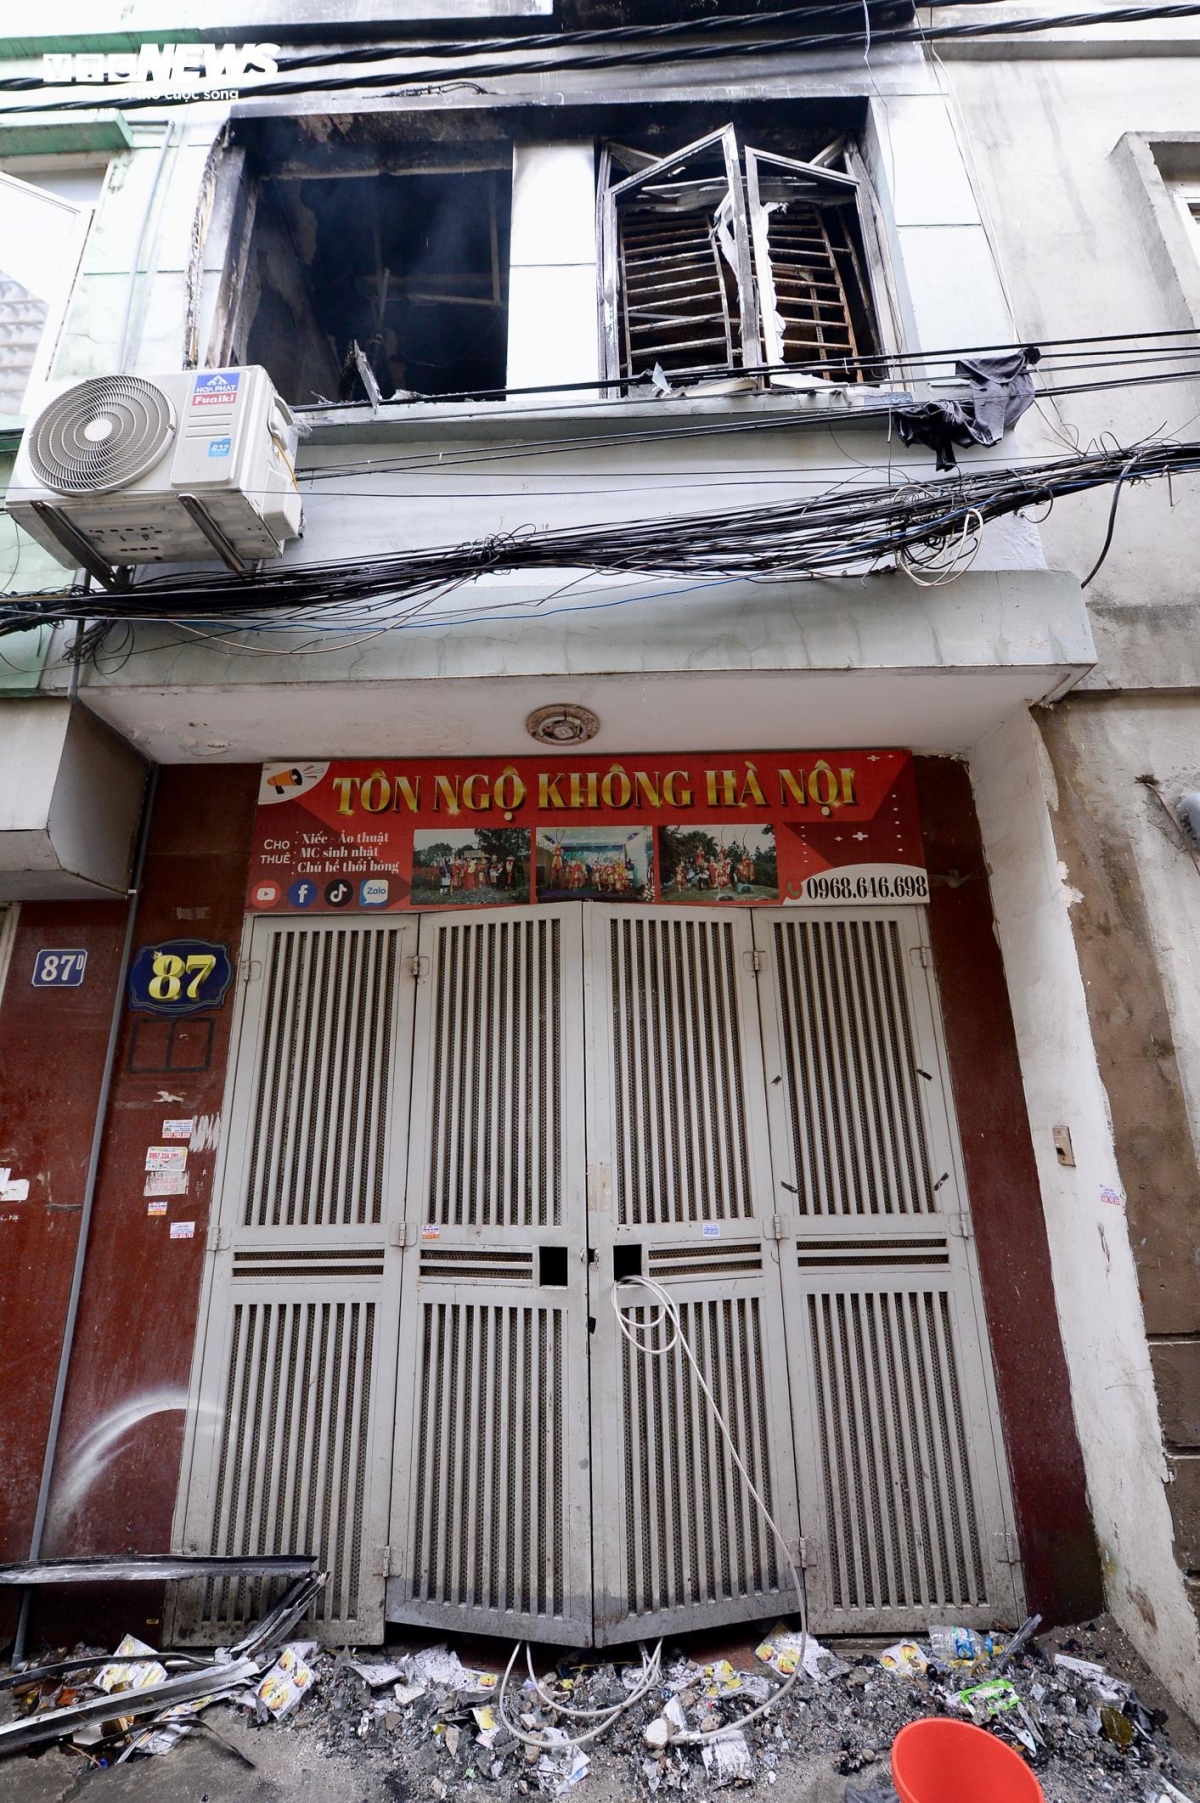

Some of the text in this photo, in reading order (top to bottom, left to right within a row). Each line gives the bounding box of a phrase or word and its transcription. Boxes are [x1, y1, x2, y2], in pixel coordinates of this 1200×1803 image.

[194, 395, 234, 404] Funiki
[211, 444, 229, 452] R32
[333, 759, 855, 821] TÔN NGỘ KHÔNG HÀ NỘI
[302, 831, 327, 844] Xiếc
[357, 831, 389, 845] thuật
[260, 852, 291, 865] THUÊ
[300, 846, 378, 859] MC sinh nhật
[297, 858, 400, 874] Chú hề thổi bóng
[367, 886, 386, 895] Zalo
[806, 875, 927, 899] 0968.646.698
[148, 954, 217, 1002] 87
